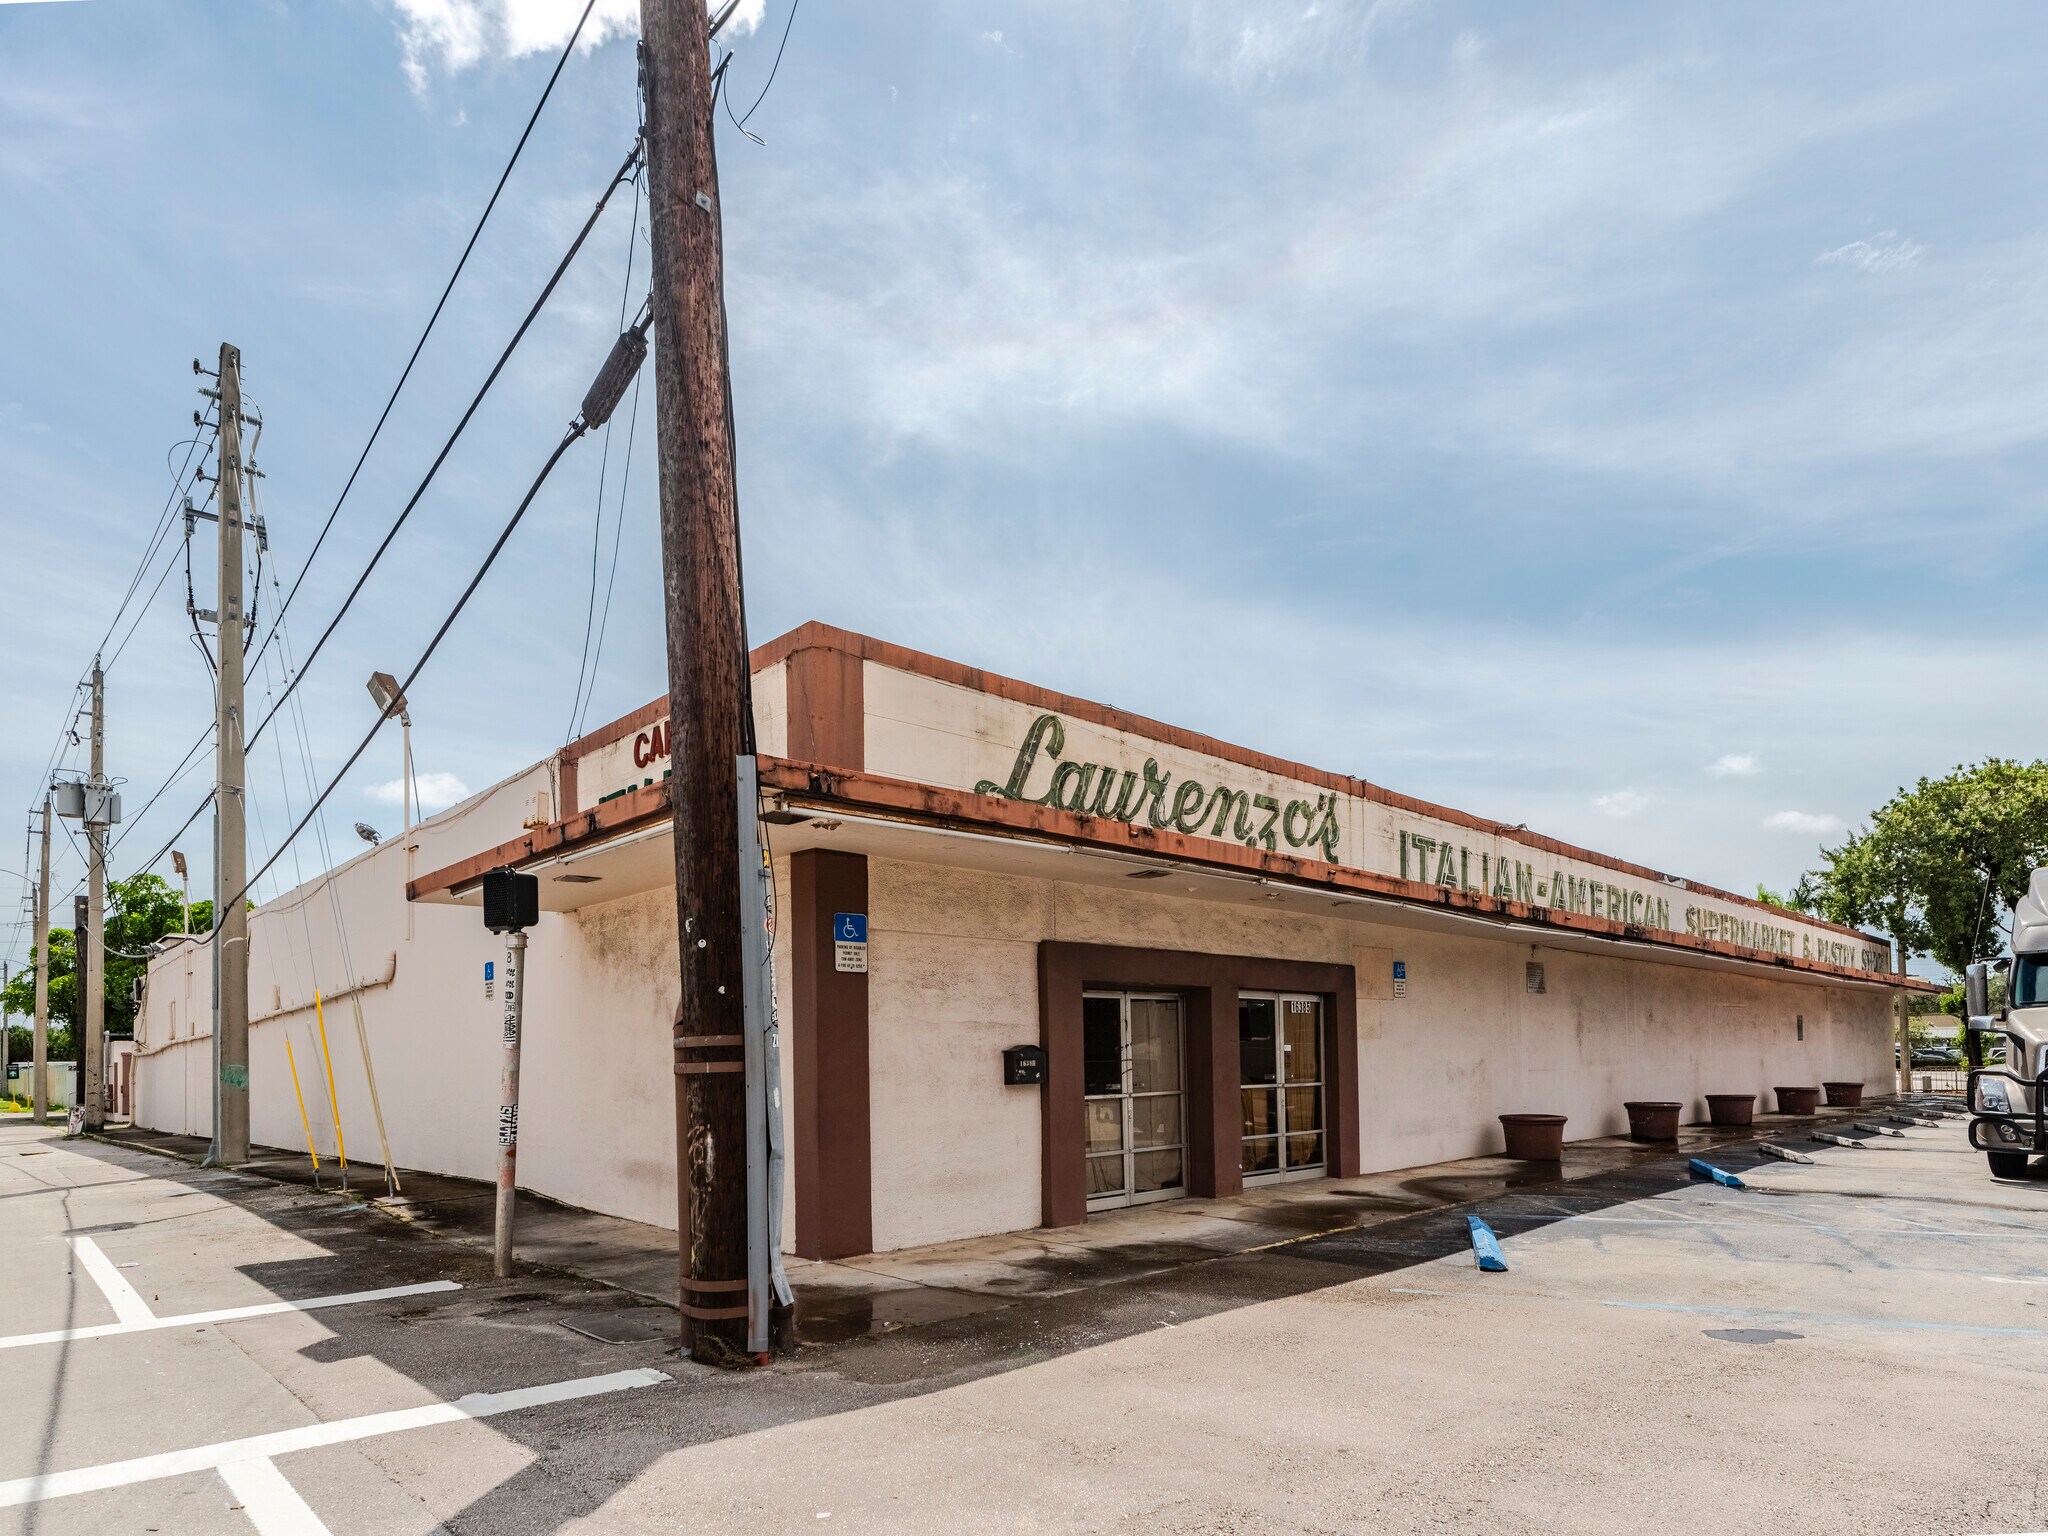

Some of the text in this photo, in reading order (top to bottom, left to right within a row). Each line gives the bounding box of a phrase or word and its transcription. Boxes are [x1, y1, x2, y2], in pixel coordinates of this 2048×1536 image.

[974, 714, 1340, 864] Laurenzo's
[1400, 829, 1670, 931] ITALIAN-AMERICAN
[1685, 903, 1795, 956] SUPERMARKET
[1817, 937, 1856, 968] PASTRY
